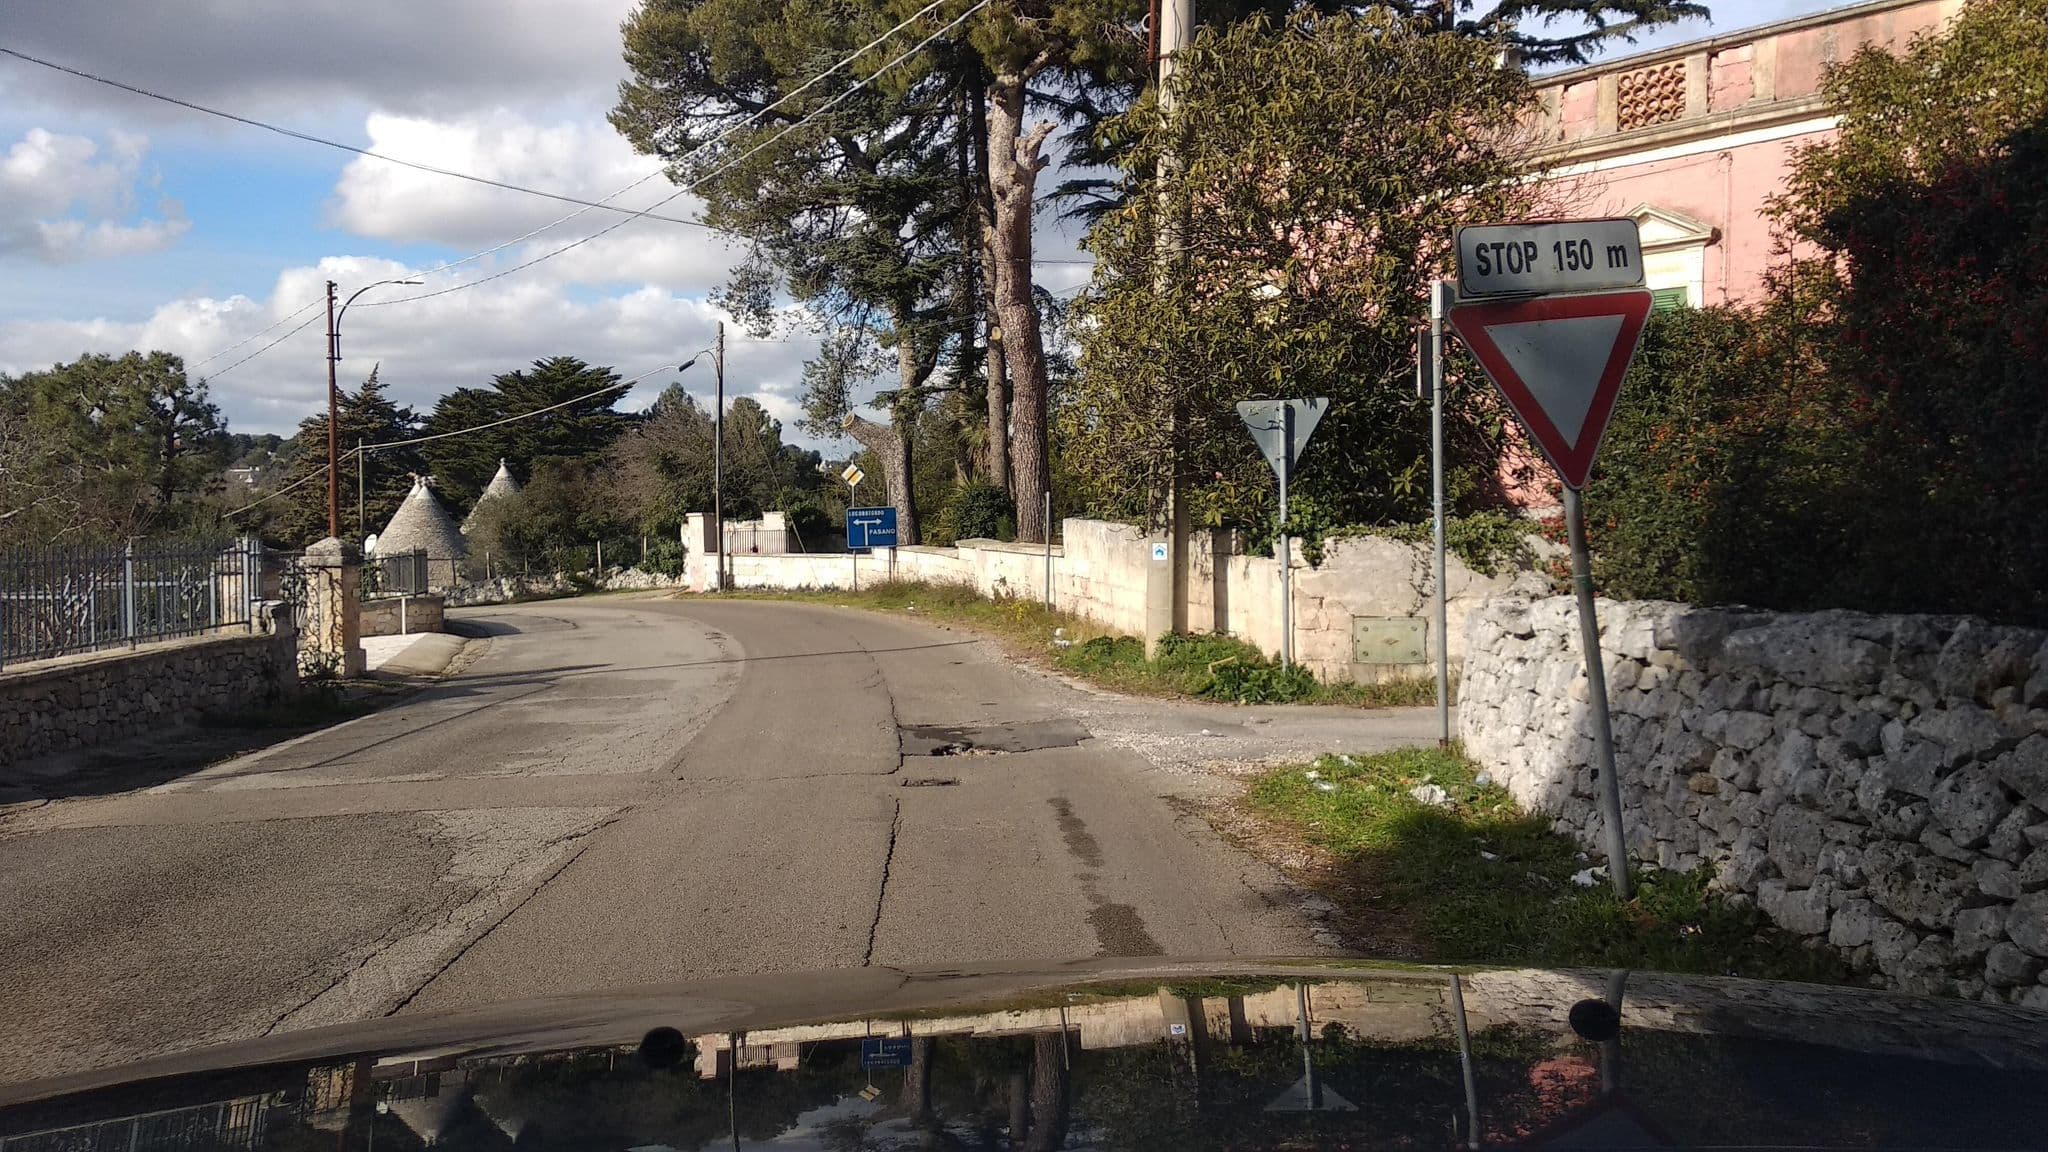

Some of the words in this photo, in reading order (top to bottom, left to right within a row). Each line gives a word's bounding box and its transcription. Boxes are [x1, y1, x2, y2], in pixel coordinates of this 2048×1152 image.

[1475, 240, 1538, 276] STOP
[1553, 238, 1594, 271] 150
[1606, 244, 1629, 268] m
[869, 528, 896, 536] FASANO
